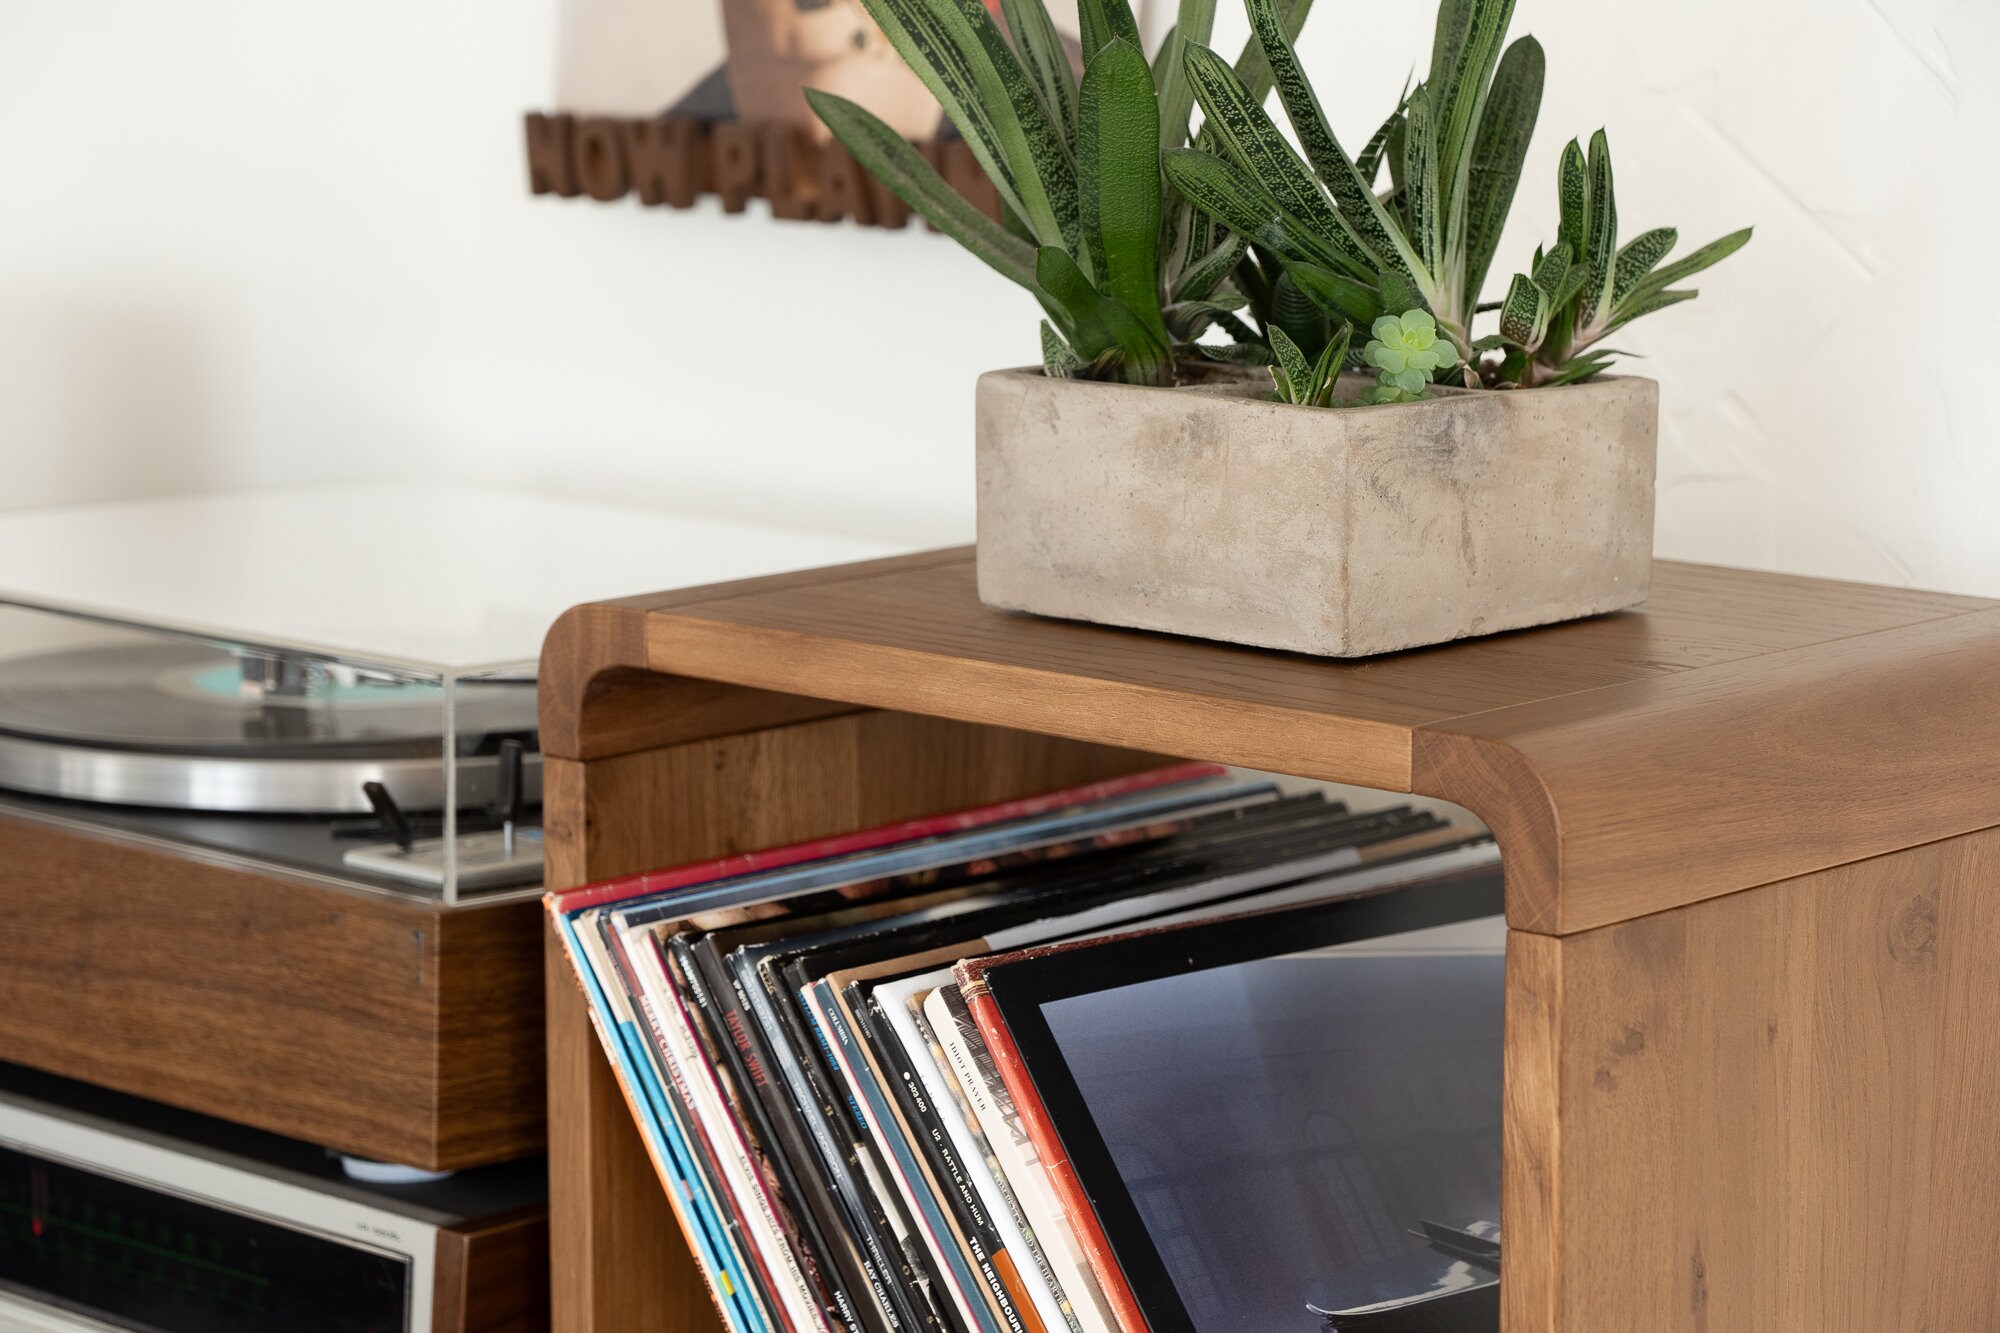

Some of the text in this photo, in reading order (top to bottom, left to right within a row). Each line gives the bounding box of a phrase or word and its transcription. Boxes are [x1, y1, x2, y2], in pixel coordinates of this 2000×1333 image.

[525, 114, 698, 208] NOW
[724, 1008, 769, 1088] TAYLOR SWIFT
[826, 1006, 850, 1046] COLUMBIA
[948, 1041, 987, 1111] IDIOT PRAYER
[845, 1093, 868, 1130] STEREO
[792, 1081, 893, 1285] MICHAEL JACKSON THRILLER
[930, 1127, 984, 1226] U2 RATTLE AND HUM
[967, 1235, 986, 1262] THE
[1019, 1225, 1034, 1247] AND
[1030, 1248, 1045, 1268] THE
[833, 1289, 854, 1324] HARRY
[862, 1259, 900, 1329] RAY CHARLES
